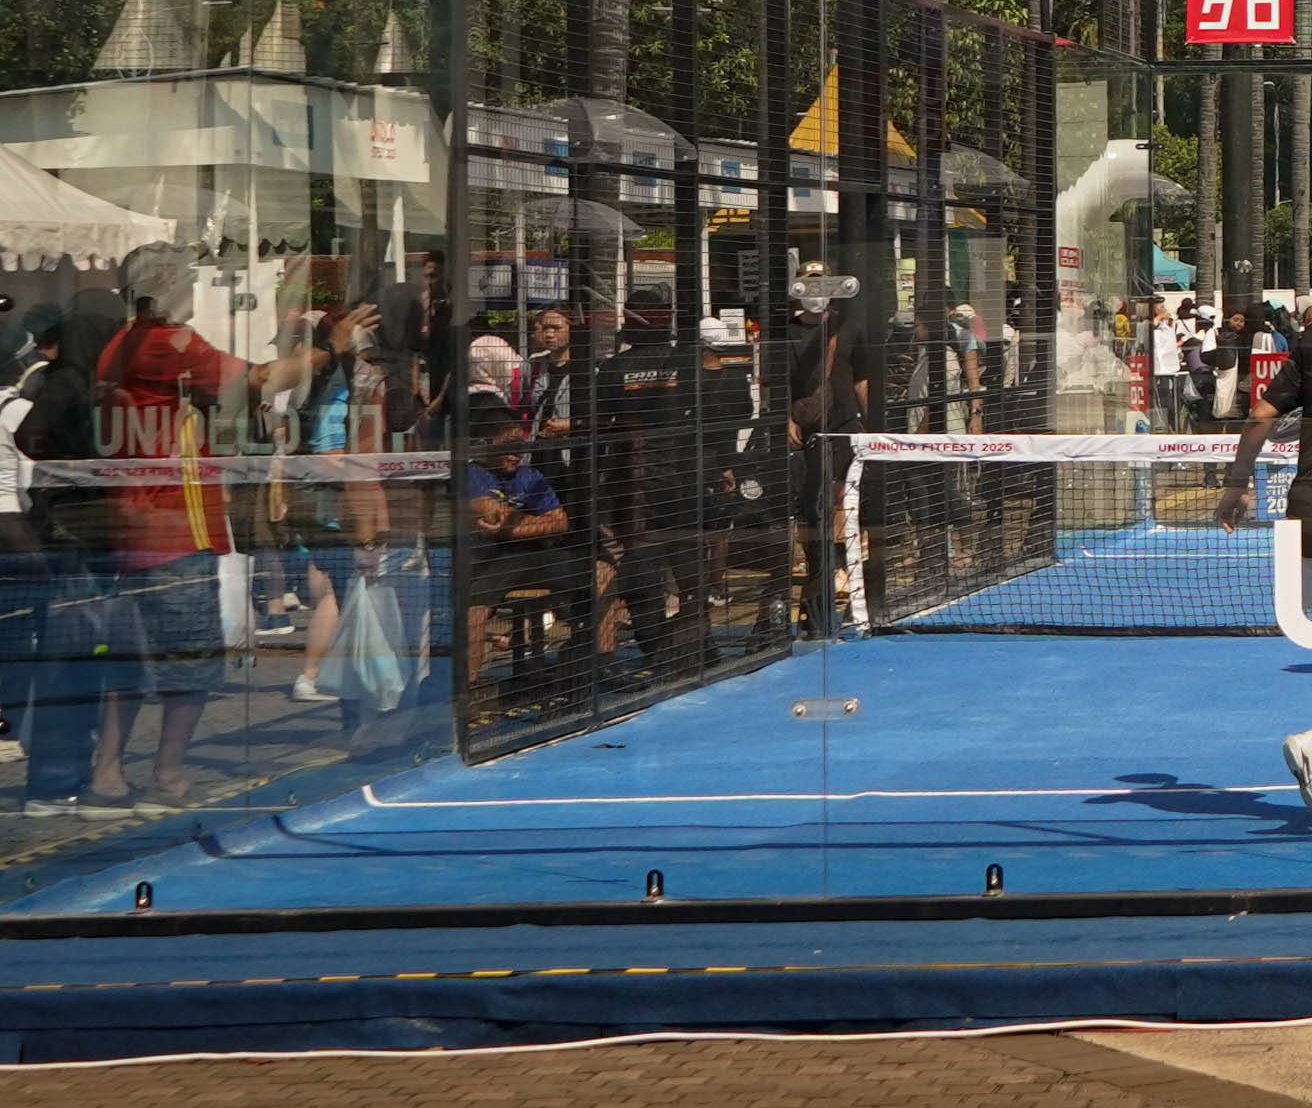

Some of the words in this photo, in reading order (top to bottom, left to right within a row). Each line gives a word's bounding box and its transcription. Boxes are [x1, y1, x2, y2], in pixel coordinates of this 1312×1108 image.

[1255, 360, 1282, 380] UN
[868, 441, 917, 453] UNIQLO
[921, 442, 975, 452] FITFEST
[981, 441, 1013, 452] 2025
[1158, 443, 1206, 454] UNIQLO
[1211, 444, 1238, 454] FITF
[1266, 472, 1296, 485] UNIQ
[1266, 498, 1288, 514] 20
